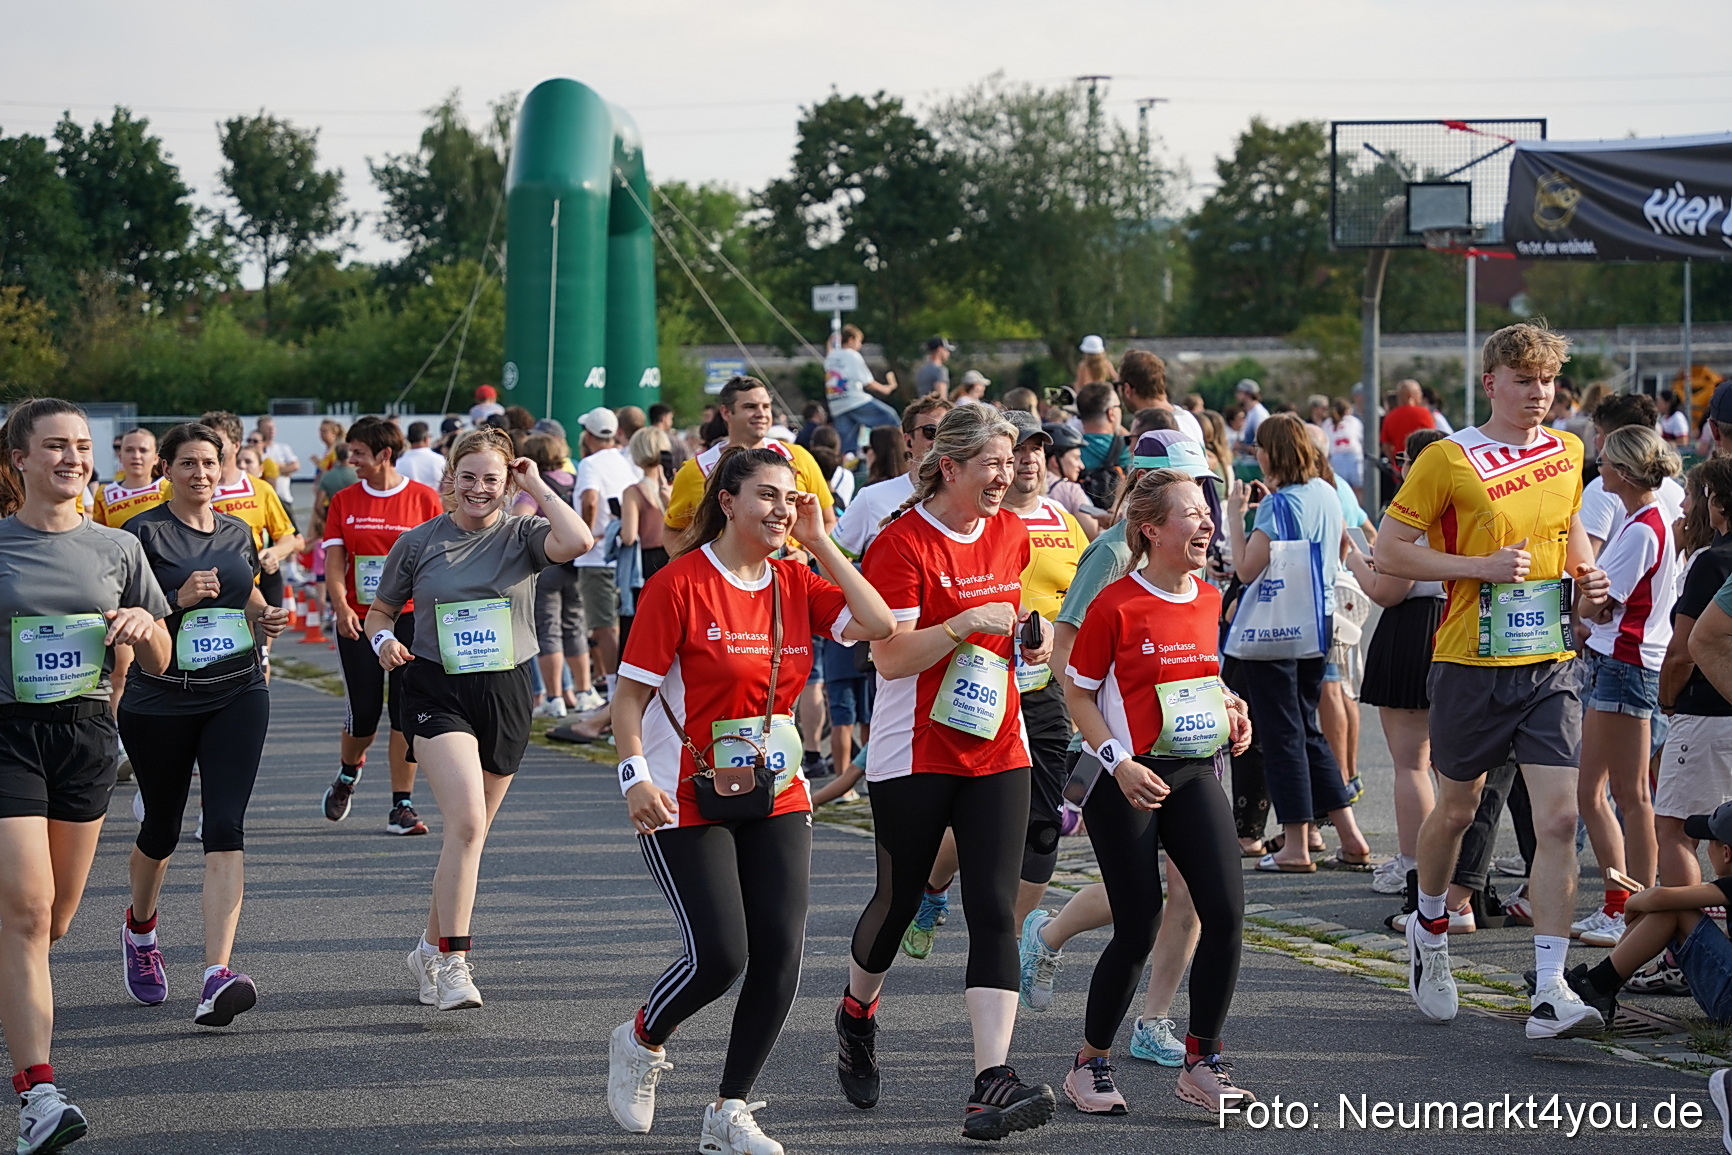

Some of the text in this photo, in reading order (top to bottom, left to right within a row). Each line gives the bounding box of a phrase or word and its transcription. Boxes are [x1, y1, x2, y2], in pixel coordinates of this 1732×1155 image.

[1643, 180, 1724, 236] Hier
[1486, 457, 1575, 502] MAX BÖGL
[108, 494, 162, 515] MAX BÖGL
[225, 500, 258, 513] BÖGL
[1031, 533, 1075, 549] BÖGL
[955, 572, 995, 587] Sparkasse
[1507, 611, 1545, 628] 1655
[453, 629, 497, 647] 1944
[724, 631, 769, 642] Sparkasse
[1257, 626, 1302, 638] VR BANK
[1504, 631, 1534, 639] Christoph
[1534, 629, 1549, 637] Fries
[192, 637, 235, 653] 1928
[457, 649, 473, 657] Julia
[472, 647, 500, 656] Stephan
[1157, 642, 1196, 654] Sparkasse
[35, 650, 81, 671] 1931
[191, 655, 216, 664] Kerstin
[18, 669, 99, 684] Katharina Eichenseer
[953, 678, 998, 707] 2596
[952, 697, 976, 712] Özlem
[976, 706, 995, 719] Yilmaz
[1175, 711, 1216, 733] 2588
[1172, 733, 1218, 743] Marta Schwarz
